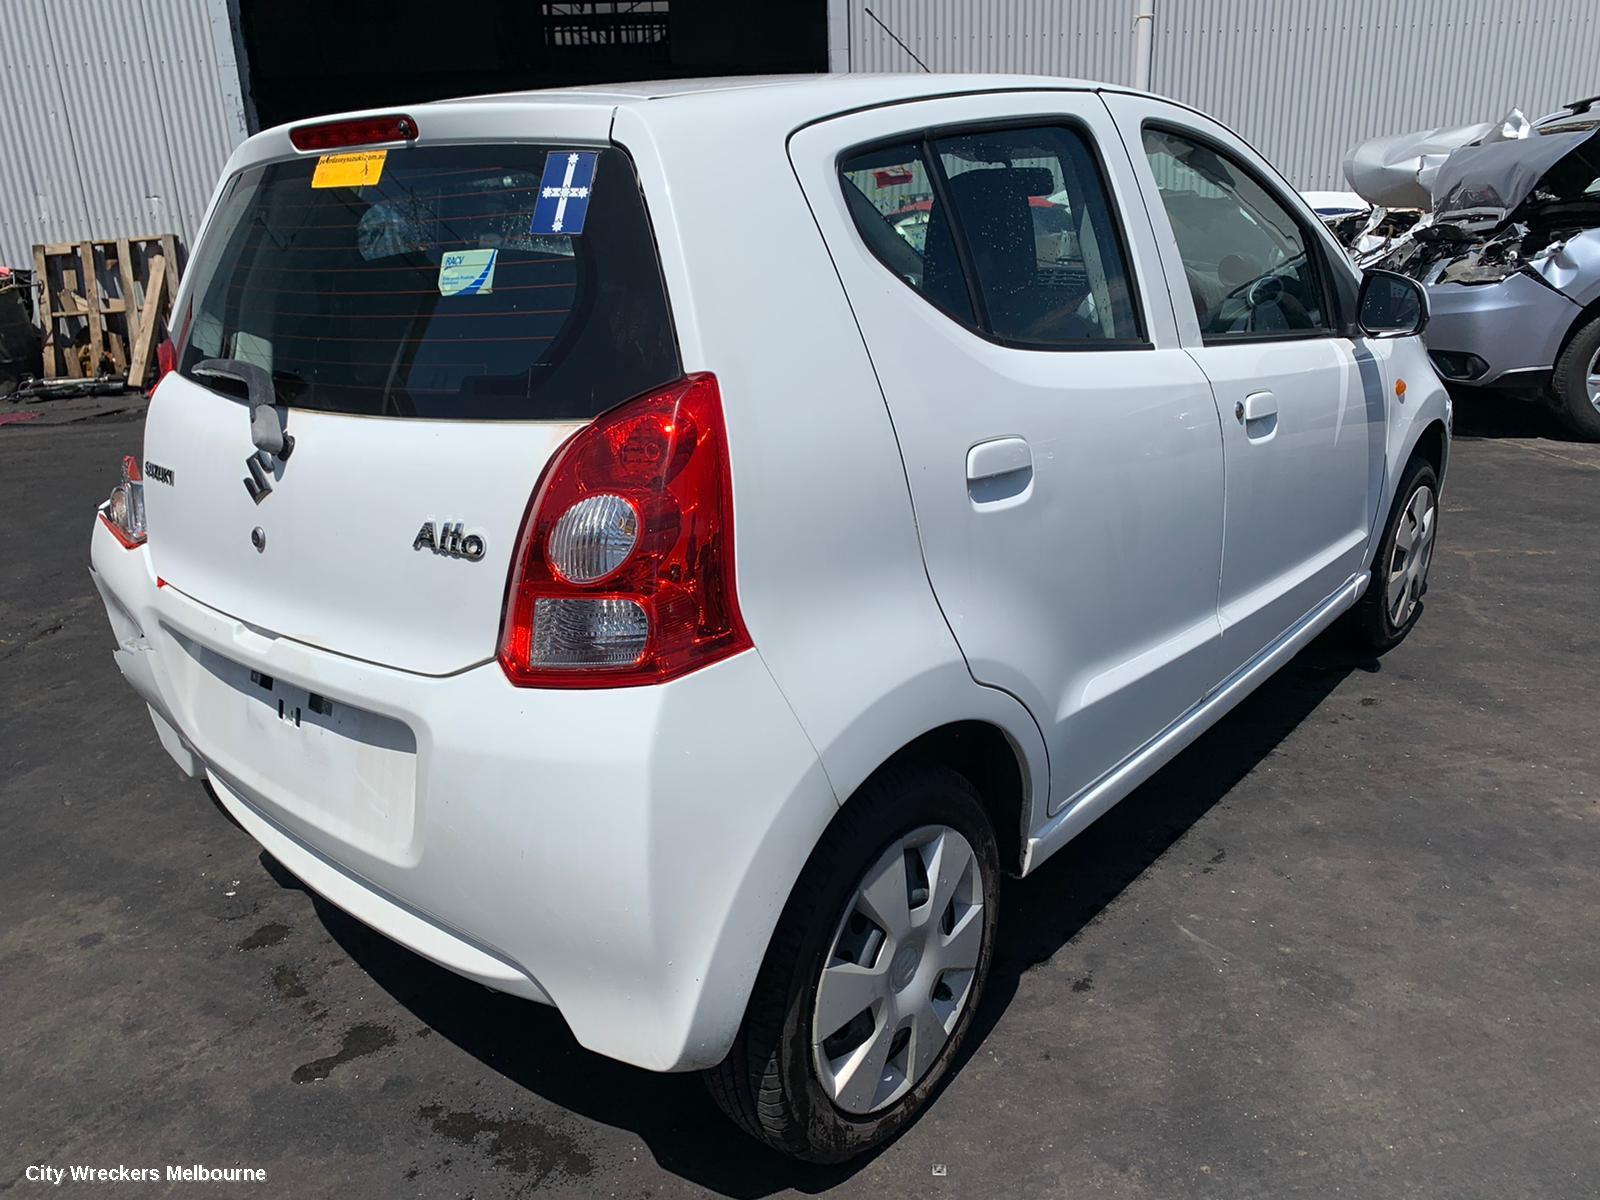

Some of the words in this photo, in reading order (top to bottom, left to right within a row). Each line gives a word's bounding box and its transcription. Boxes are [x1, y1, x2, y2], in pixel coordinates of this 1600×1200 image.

[446, 256, 464, 265] RACV
[144, 461, 174, 487] SUZUKI
[412, 521, 486, 562] Alto
